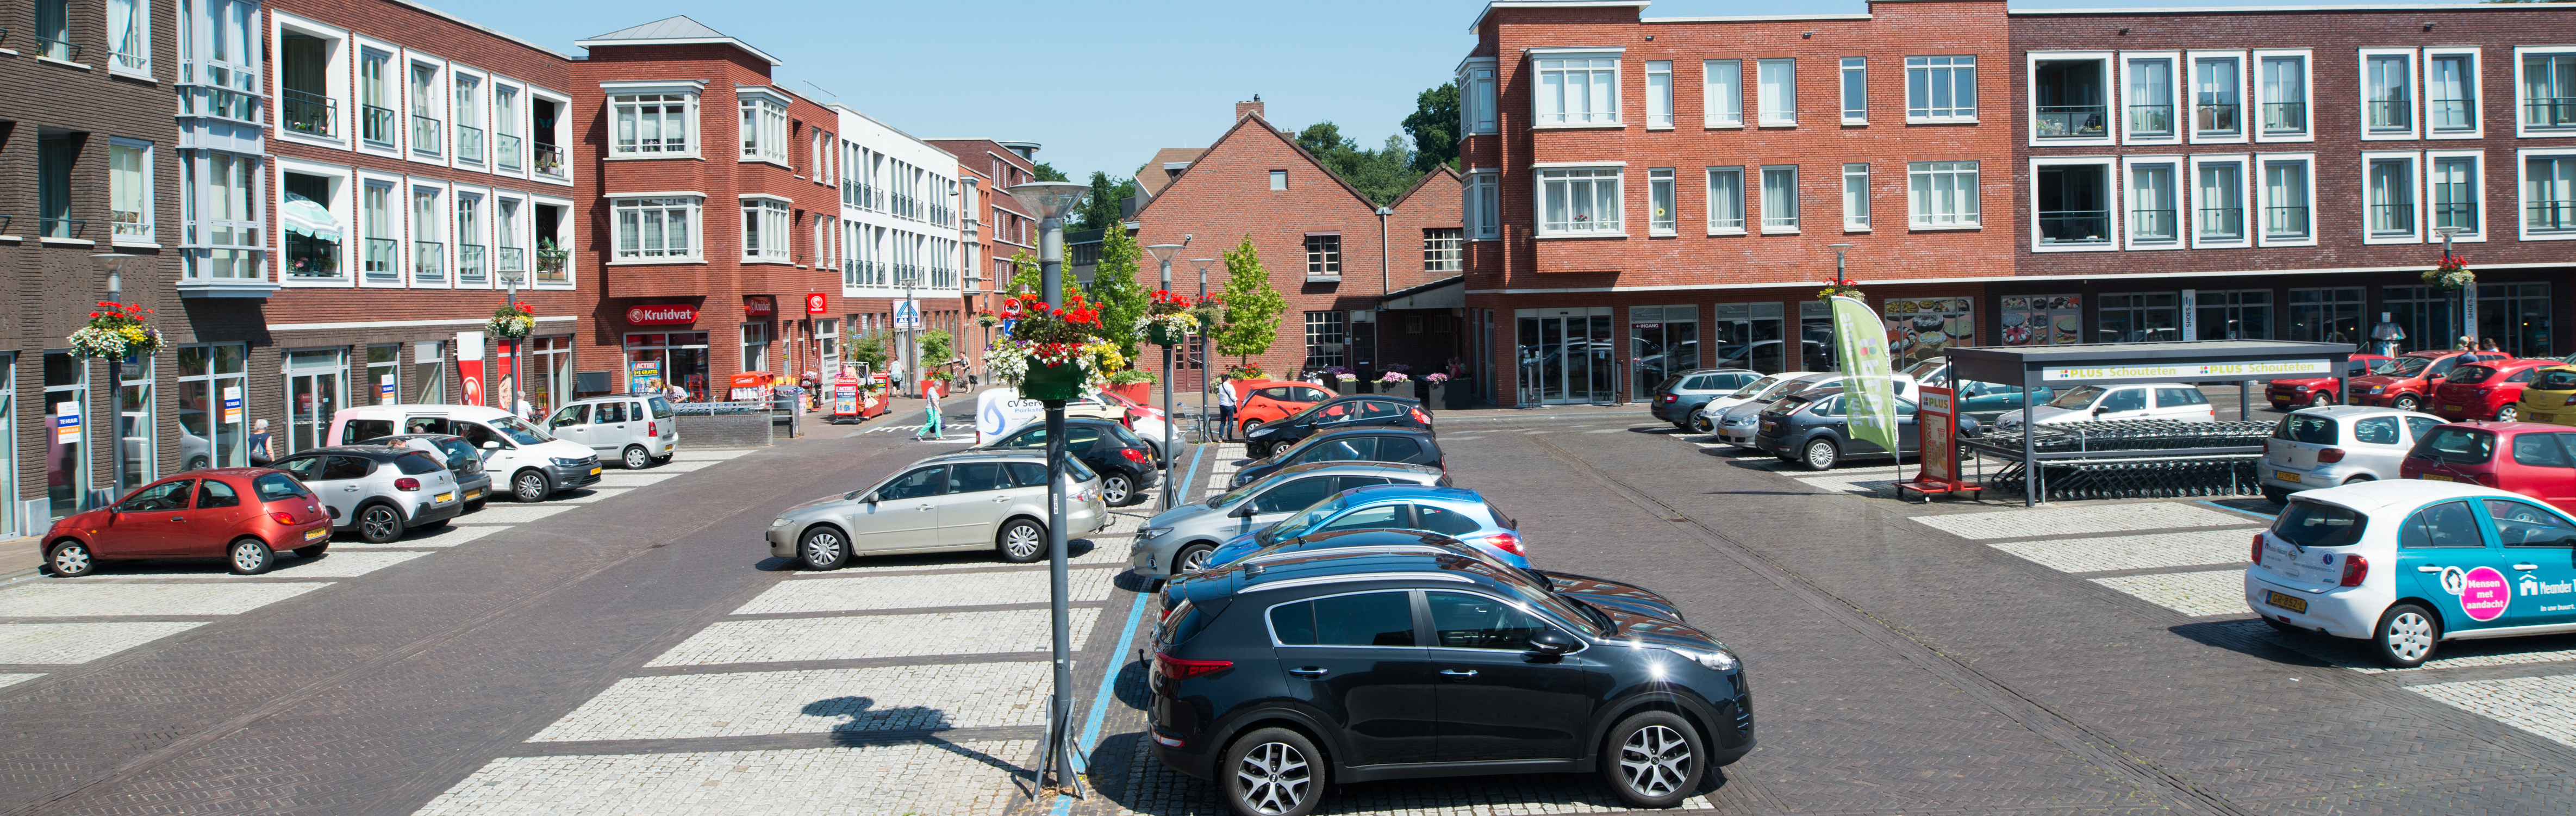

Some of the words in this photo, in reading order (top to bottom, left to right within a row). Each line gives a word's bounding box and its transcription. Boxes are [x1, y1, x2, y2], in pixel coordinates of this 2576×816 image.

[755, 301, 770, 311] Kruidvat
[645, 309, 691, 320] Kruidvat
[2070, 369, 2103, 377] PLUS
[2110, 367, 2176, 376] Schouteten
[2210, 365, 2242, 373] PLUS
[2249, 363, 2314, 372] Schouteten
[1929, 397, 1948, 409] PLUS
[2278, 472, 2299, 481] 22-PS-RG
[2468, 580, 2500, 588] Mensen
[2540, 580, 2572, 594] Meander
[2477, 590, 2493, 599] met
[2273, 594, 2303, 610] GR-852-L
[2466, 600, 2504, 609] aandacht
